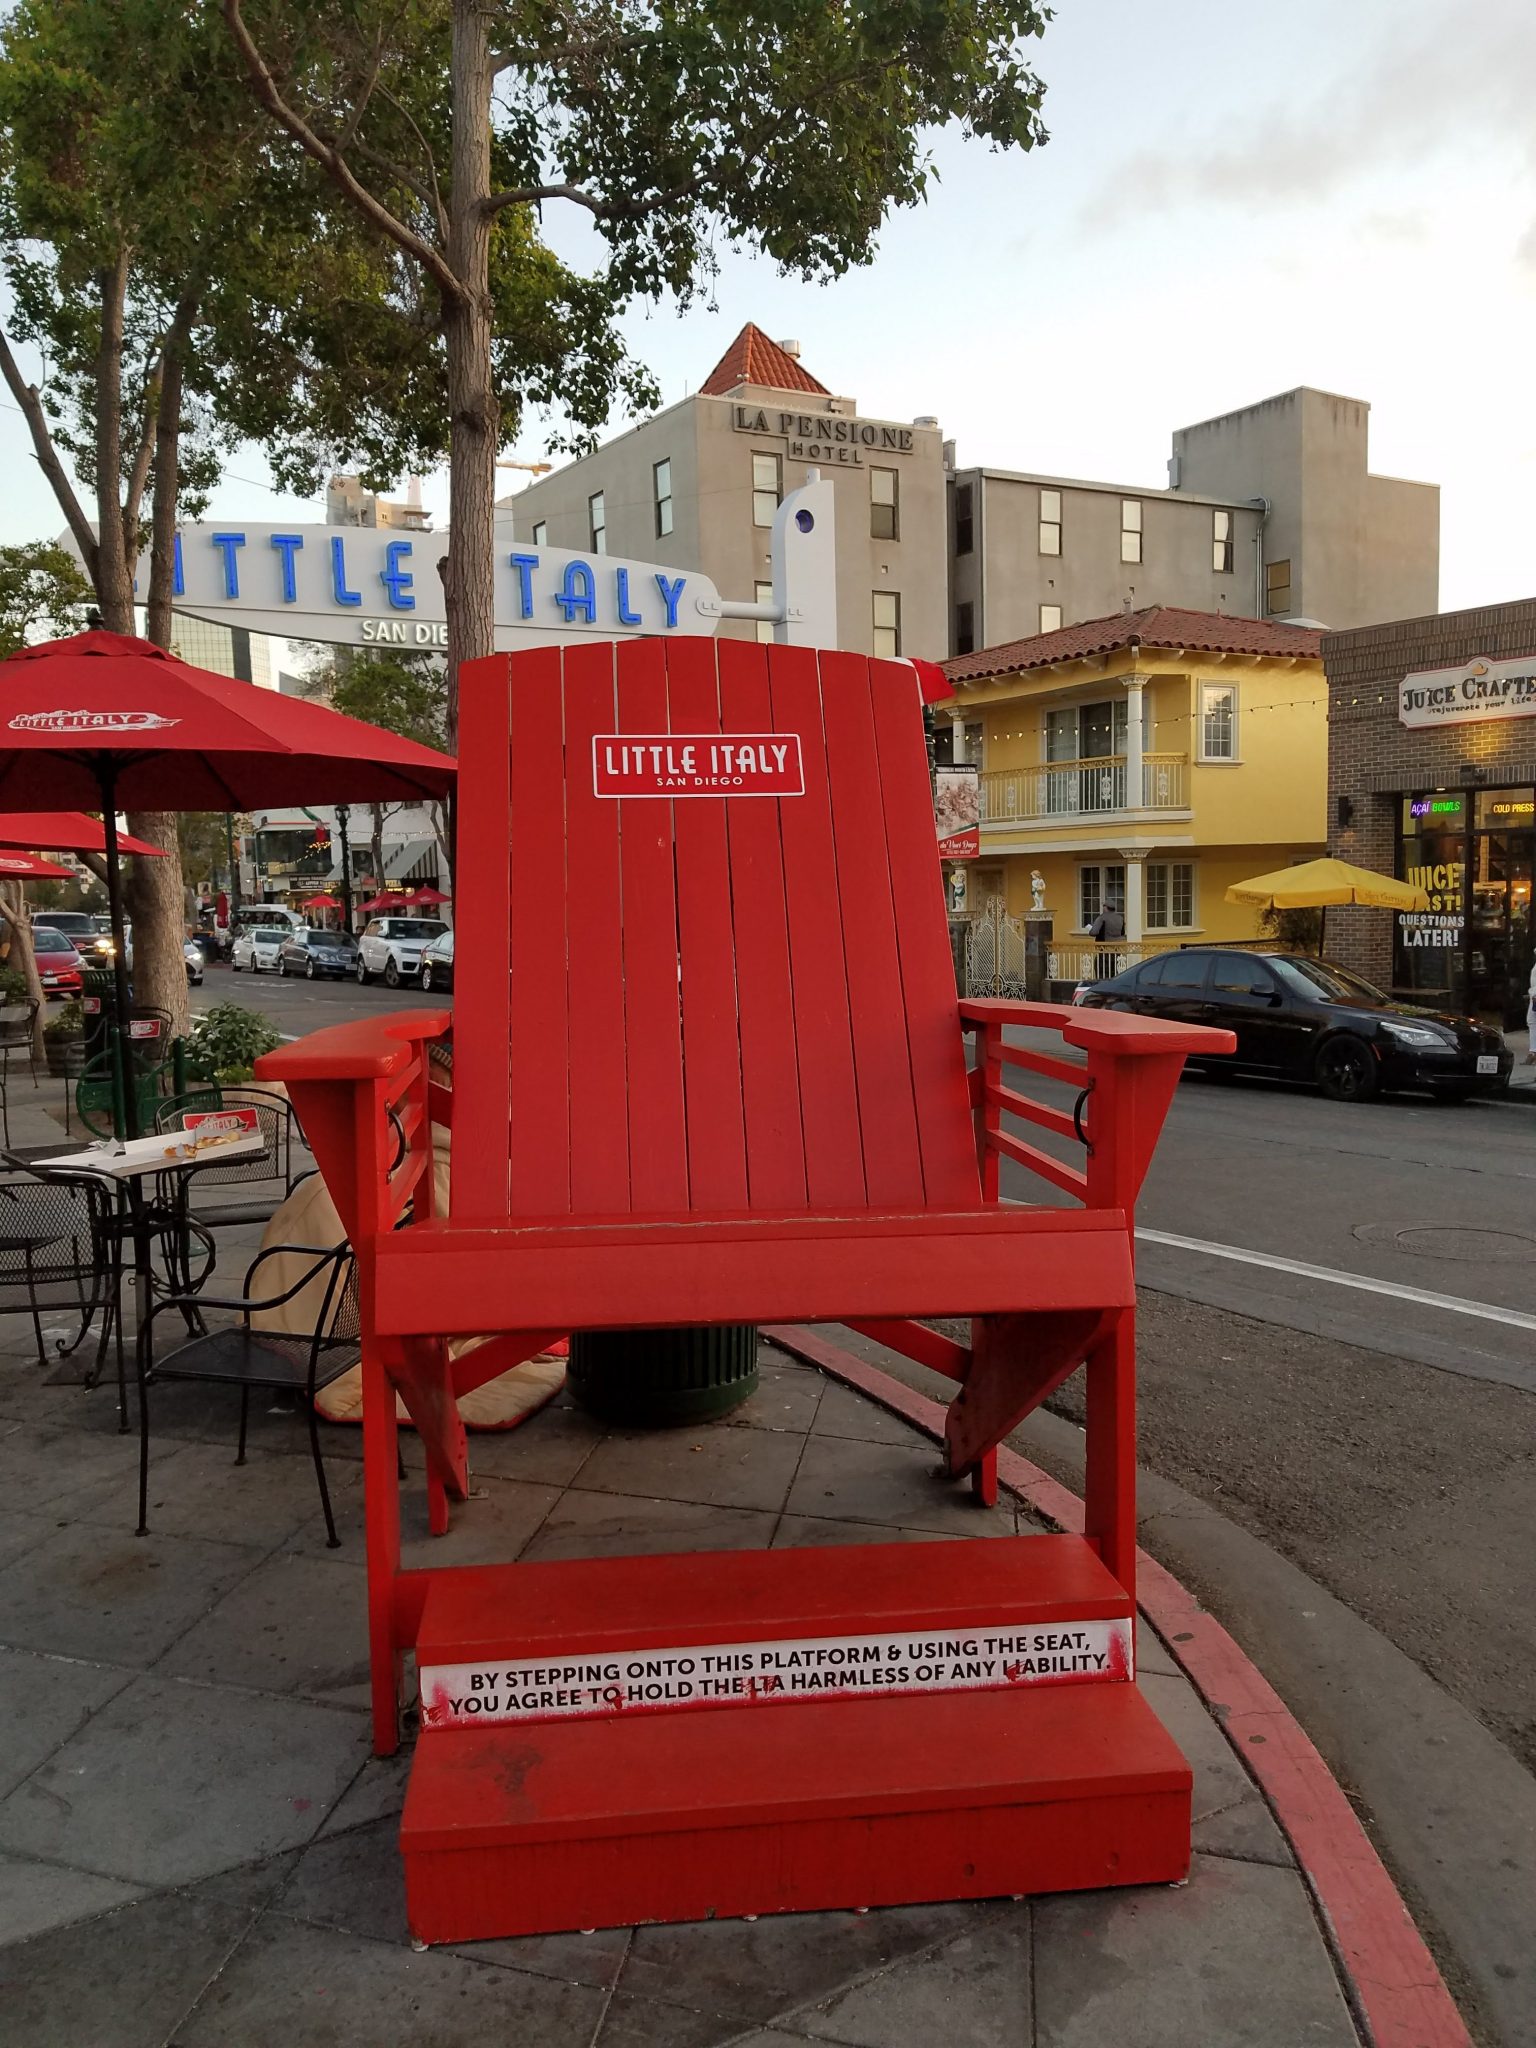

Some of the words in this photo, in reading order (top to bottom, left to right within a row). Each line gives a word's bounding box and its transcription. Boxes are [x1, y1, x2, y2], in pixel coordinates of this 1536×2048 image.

[737, 407, 770, 431] LA
[780, 412, 914, 450] PENSIONE
[792, 441, 864, 464] HOTEL
[134, 532, 416, 610] ITTLE
[510, 552, 687, 628] TALY
[362, 619, 407, 643] SAN
[415, 624, 449, 646] DIE
[1402, 684, 1456, 712] JUICE
[20, 717, 65, 727] LITTLE
[72, 714, 132, 726] ITALY
[605, 745, 696, 775] LITTLE
[710, 744, 788, 774] ITALY
[656, 776, 687, 786] SAN
[694, 776, 743, 786] DIEGO
[1432, 801, 1461, 813] BOWLS
[1493, 804, 1511, 813] COLD
[1398, 913, 1465, 928] QUESTIONS
[1403, 929, 1459, 947] LATER!
[470, 1672, 499, 1691] BY
[505, 1663, 620, 1688] STEPPING
[626, 1658, 696, 1679] ONTO
[700, 1654, 754, 1673] THIS
[760, 1646, 881, 1670] PLATFORM
[887, 1644, 902, 1661] &
[908, 1640, 978, 1660] USING
[984, 1636, 1028, 1655] THE
[1033, 1632, 1091, 1651] SEAT,
[448, 1697, 499, 1716] YOU
[505, 1690, 582, 1711] AGREE
[587, 1686, 621, 1706] TO
[627, 1681, 693, 1701] HOLD
[698, 1676, 744, 1696] THE
[791, 1664, 910, 1690] HARMLESS
[915, 1663, 945, 1682] OF
[950, 1660, 996, 1680] ANY
